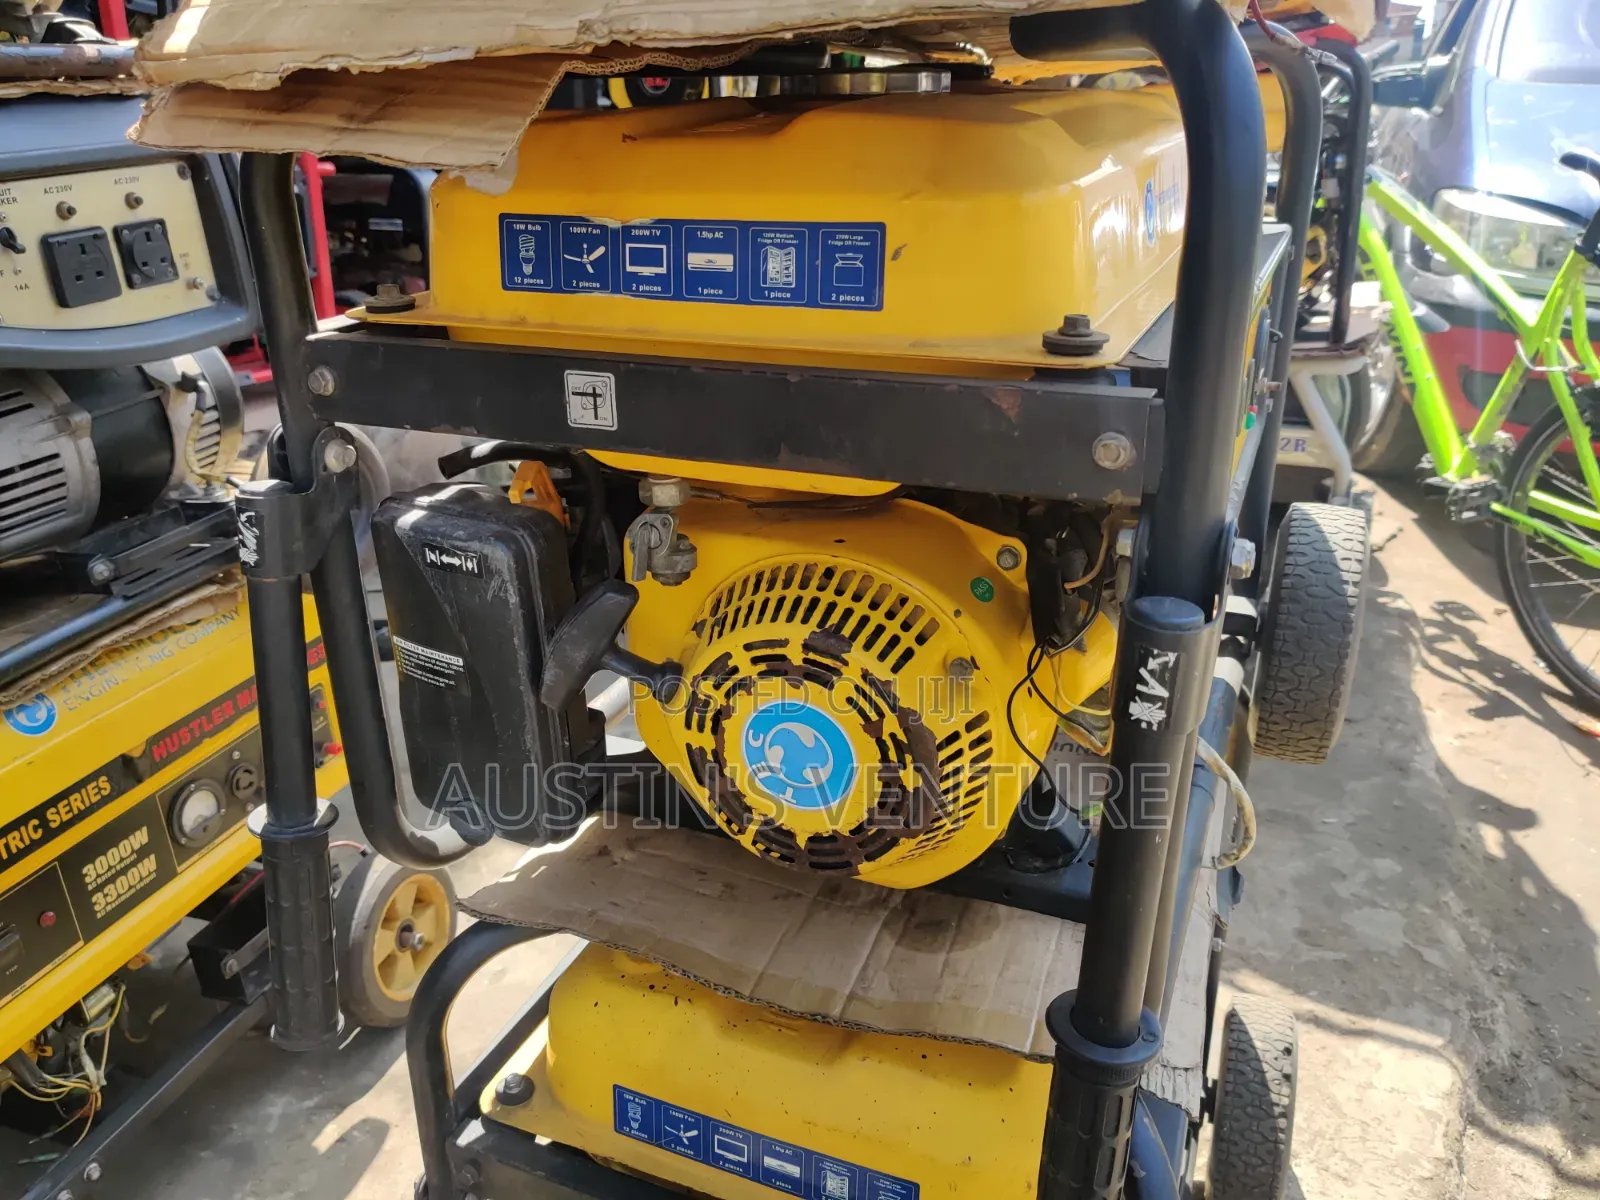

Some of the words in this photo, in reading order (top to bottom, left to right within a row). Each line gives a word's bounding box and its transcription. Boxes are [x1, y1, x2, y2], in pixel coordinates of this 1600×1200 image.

[0, 197, 18, 206] KER
[570, 226, 587, 234] 100W
[697, 231, 714, 239] 1.5hp
[579, 280, 600, 288] pieces
[640, 284, 662, 292] pieces
[840, 294, 865, 302] pieces
[176, 606, 241, 650] COMPANY
[152, 700, 236, 762] HUSTLER
[46, 776, 111, 828] SERIES
[82, 825, 149, 884] 3000W
[92, 853, 157, 912] 3300W
